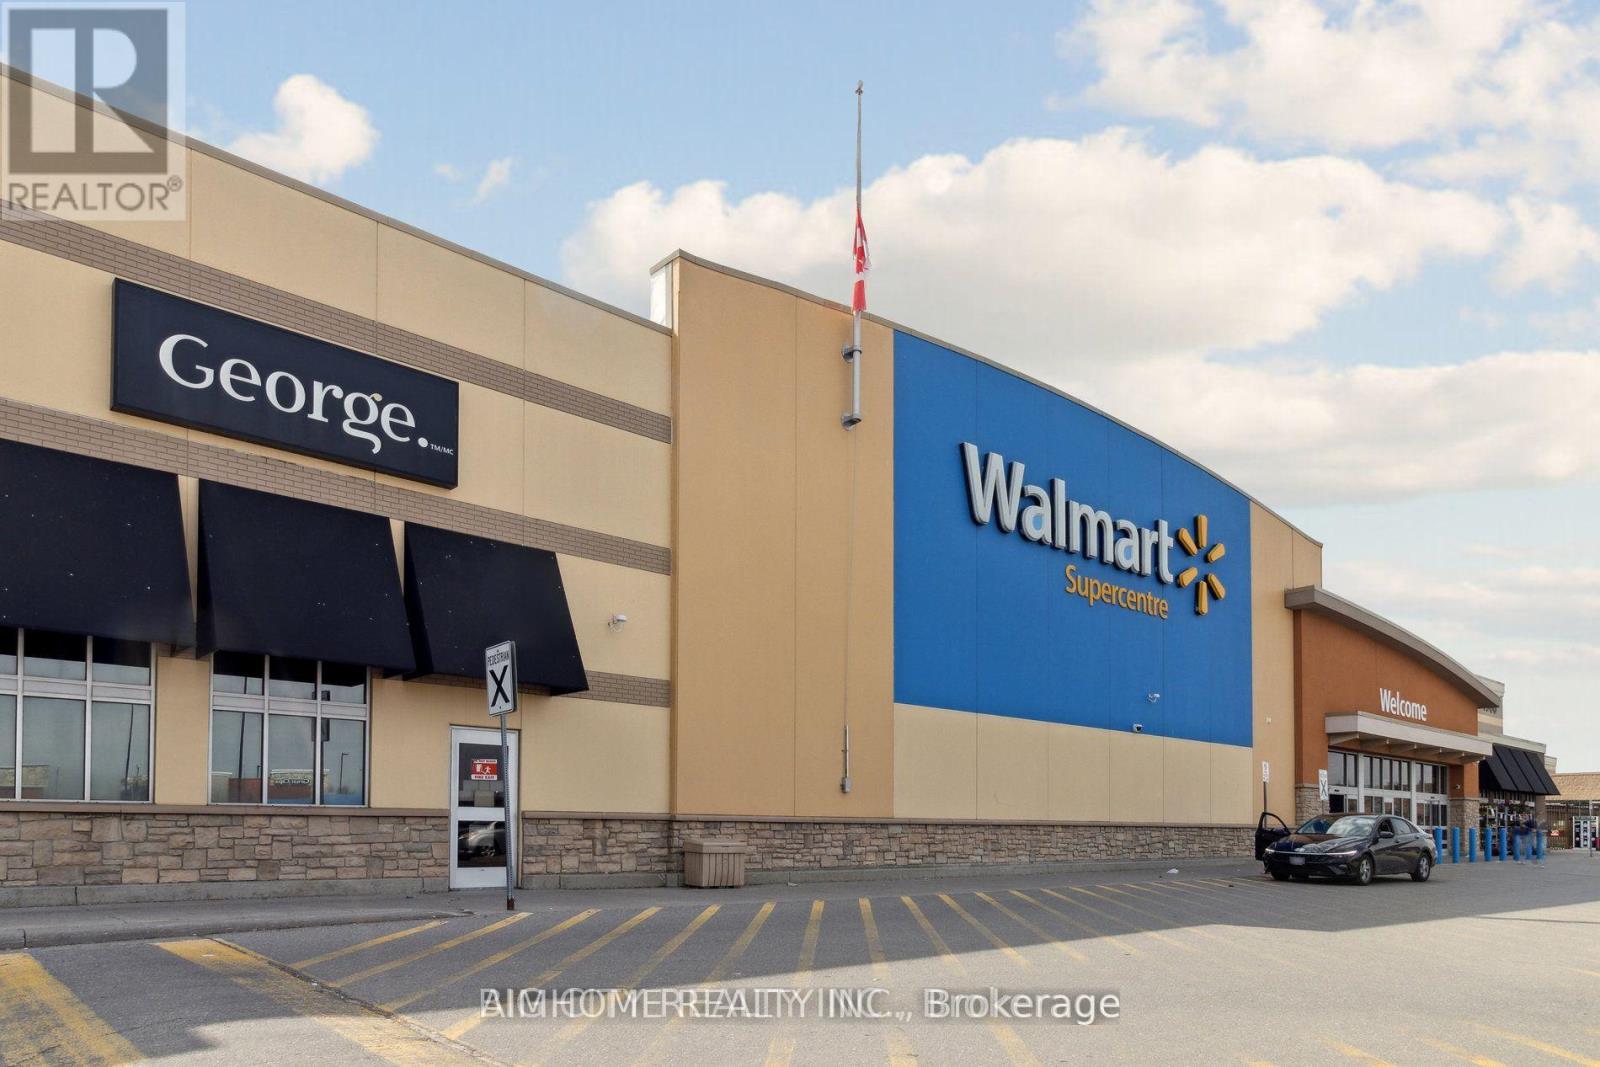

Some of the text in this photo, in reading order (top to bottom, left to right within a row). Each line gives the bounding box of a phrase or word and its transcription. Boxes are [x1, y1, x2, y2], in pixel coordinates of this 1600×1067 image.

[960, 442, 1174, 585] Walmart
[1065, 564, 1169, 620] Supercentre
[1379, 687, 1428, 722] Welcome
